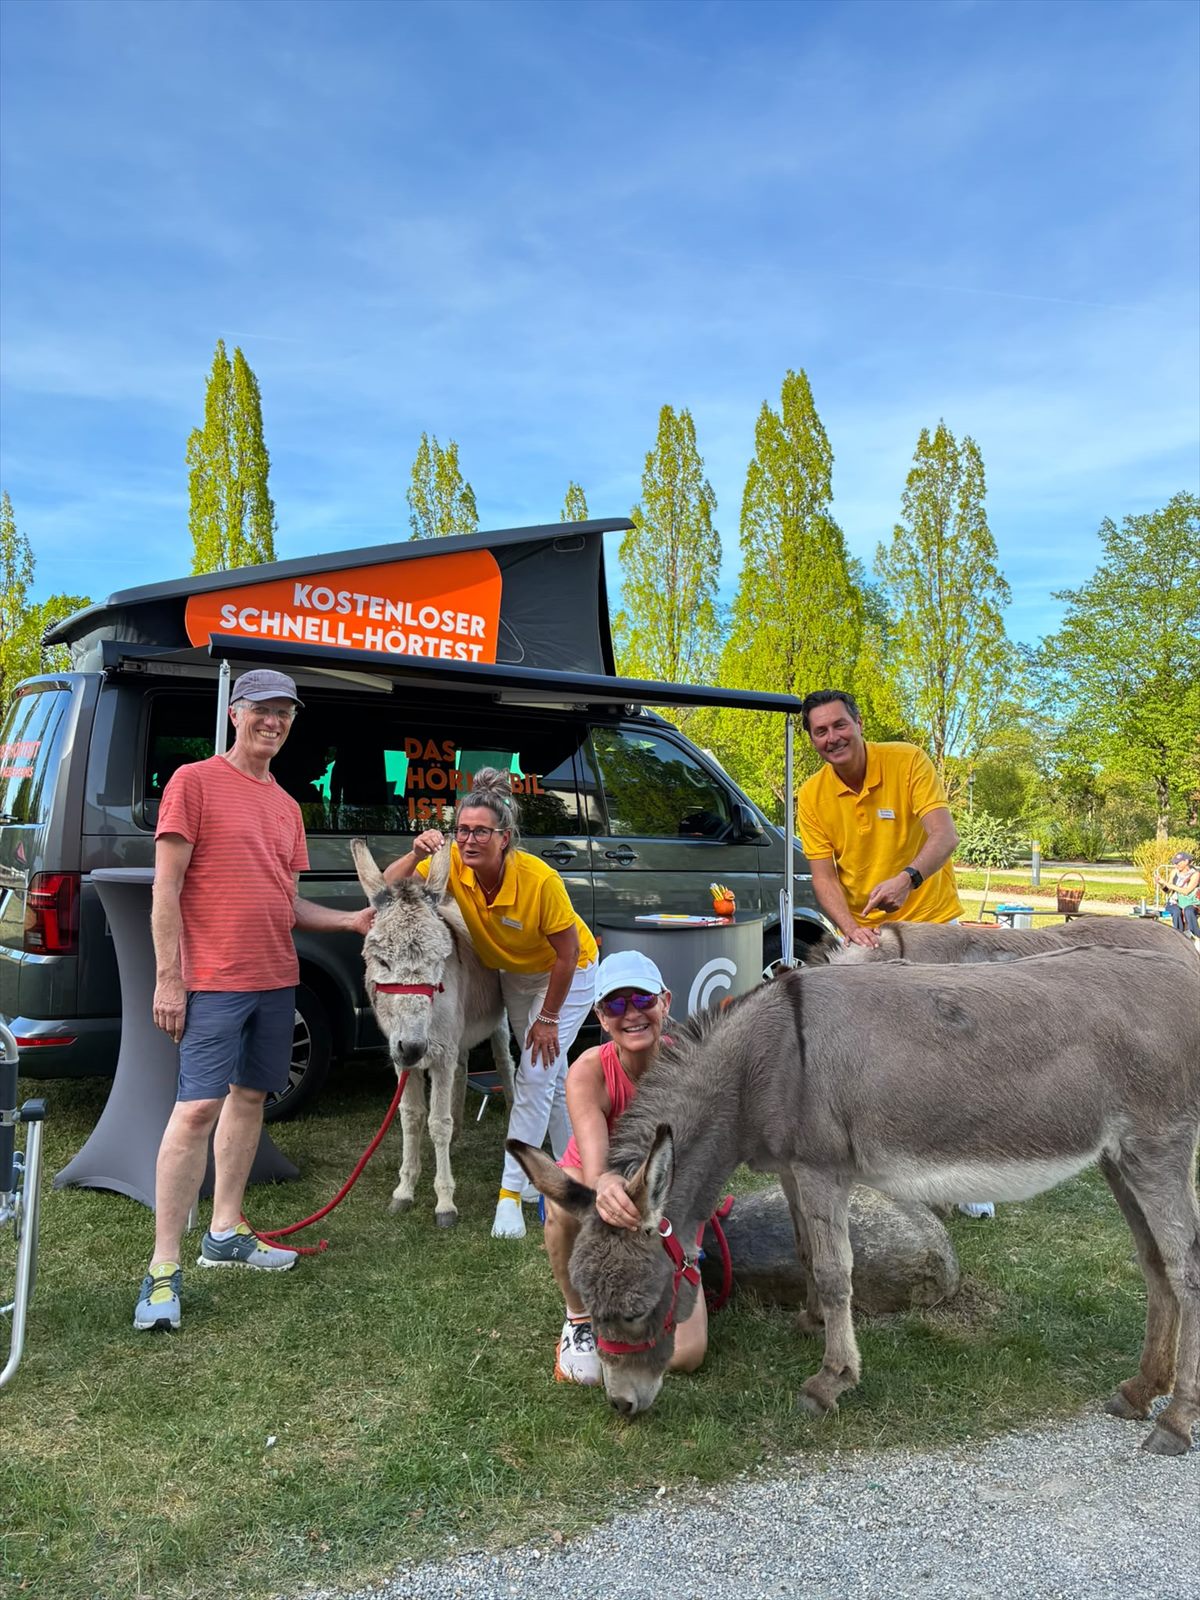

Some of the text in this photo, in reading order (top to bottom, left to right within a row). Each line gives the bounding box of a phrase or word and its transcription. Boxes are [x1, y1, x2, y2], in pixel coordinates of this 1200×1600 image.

[293, 582, 486, 638] KOSTENLOSER
[219, 604, 484, 663] SCHNELL-HÖRTEST
[404, 737, 456, 762] DAS
[407, 763, 545, 795] HÖRBIL
[408, 797, 448, 821] IST
